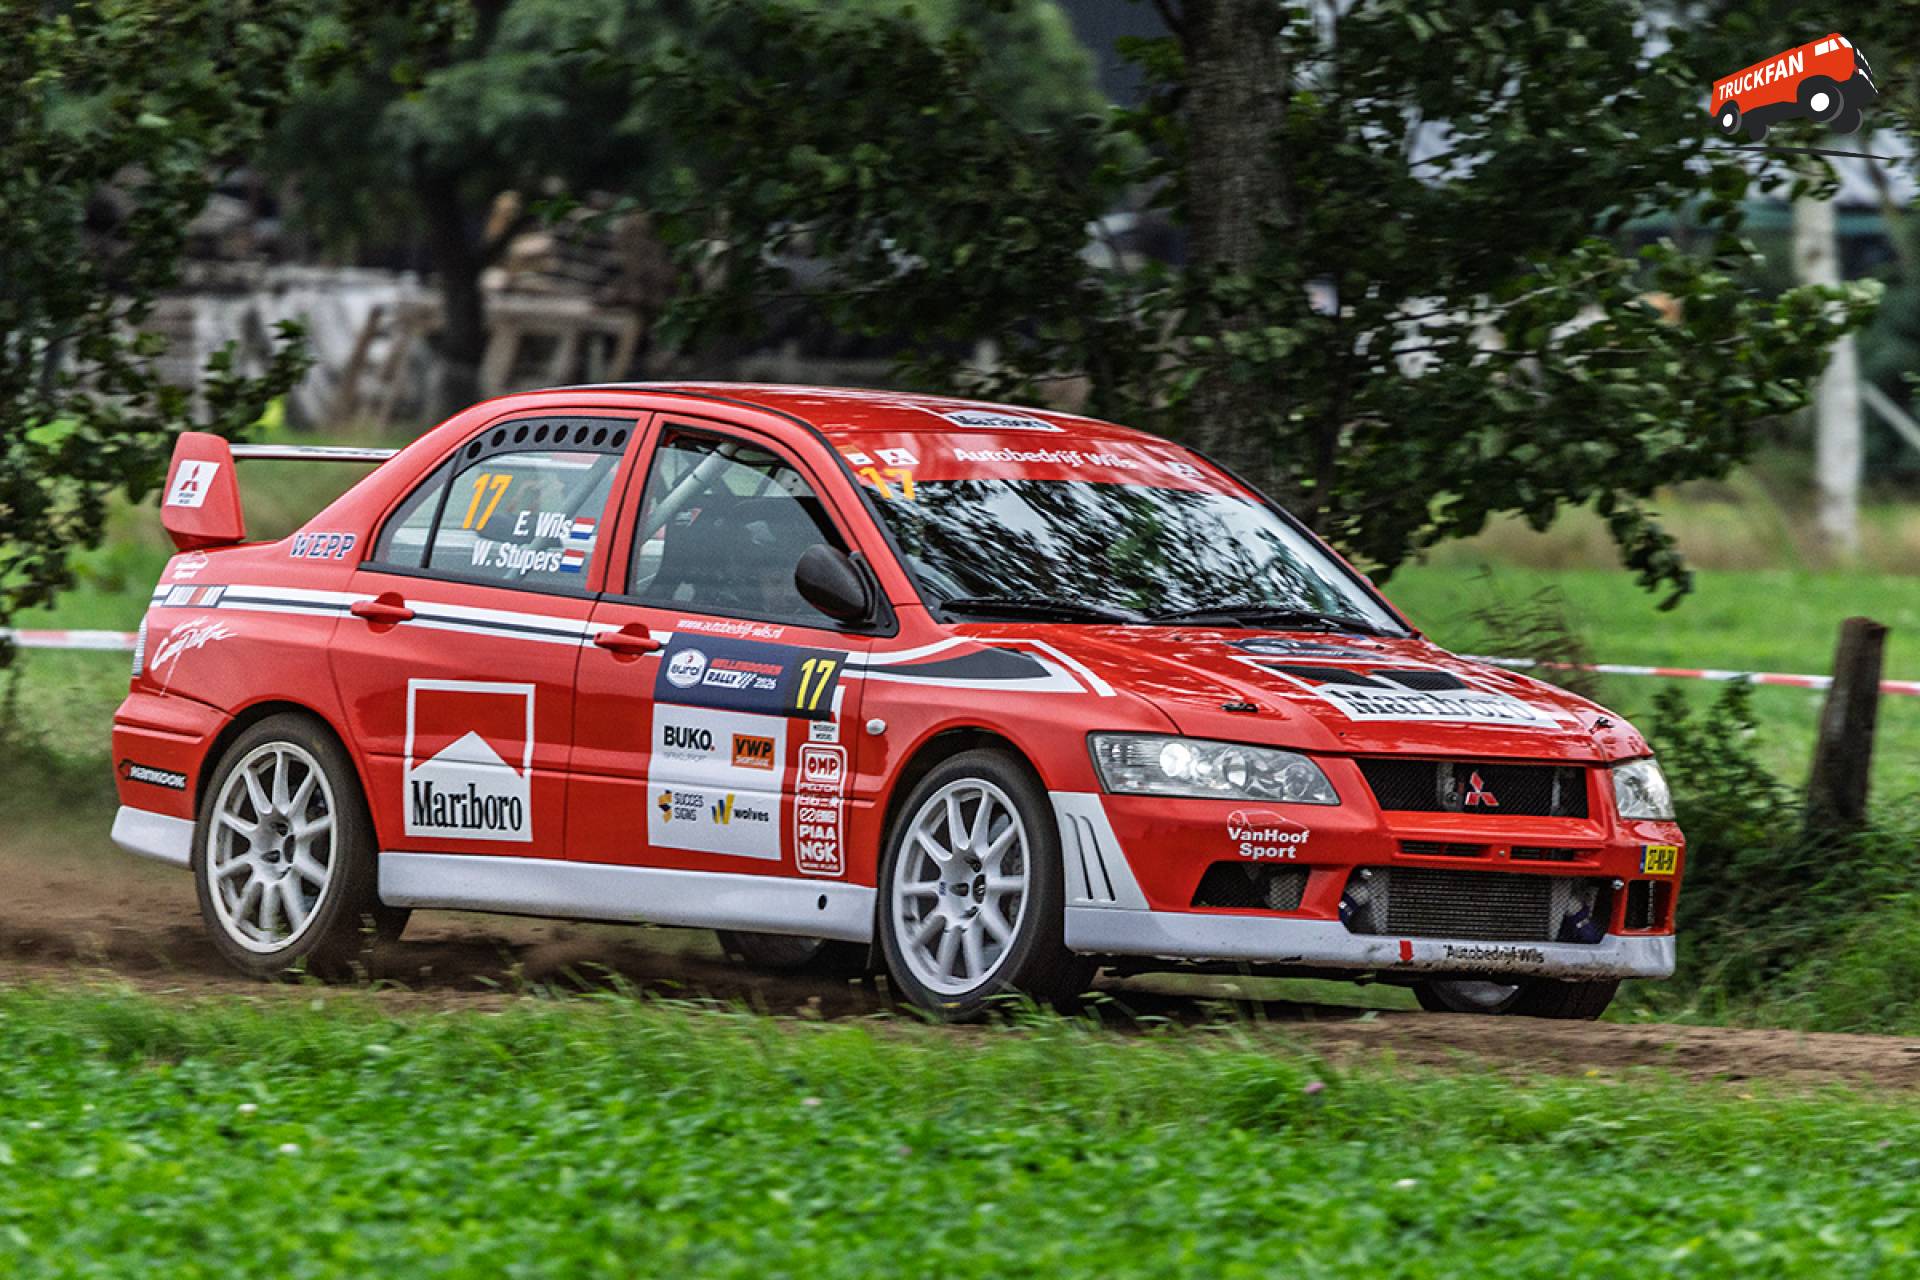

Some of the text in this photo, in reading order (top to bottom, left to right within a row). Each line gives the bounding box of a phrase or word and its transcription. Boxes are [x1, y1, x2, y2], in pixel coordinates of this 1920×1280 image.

[954, 448, 1138, 470] Autobedrijf Wils
[857, 467, 916, 501] 17
[462, 473, 513, 531] 17
[513, 510, 574, 539] E. Wils
[289, 532, 356, 560] WEPP
[471, 540, 492, 566] W.
[707, 671, 737, 684] RALLY
[796, 658, 837, 712] 17
[1325, 688, 1537, 721] Marlboro
[808, 756, 838, 775] OMP
[411, 780, 523, 831] Marlboro
[799, 824, 837, 840] PIAA
[1227, 827, 1310, 844] VanHoof
[800, 842, 838, 863] NGK
[1239, 843, 1297, 860] Sport
